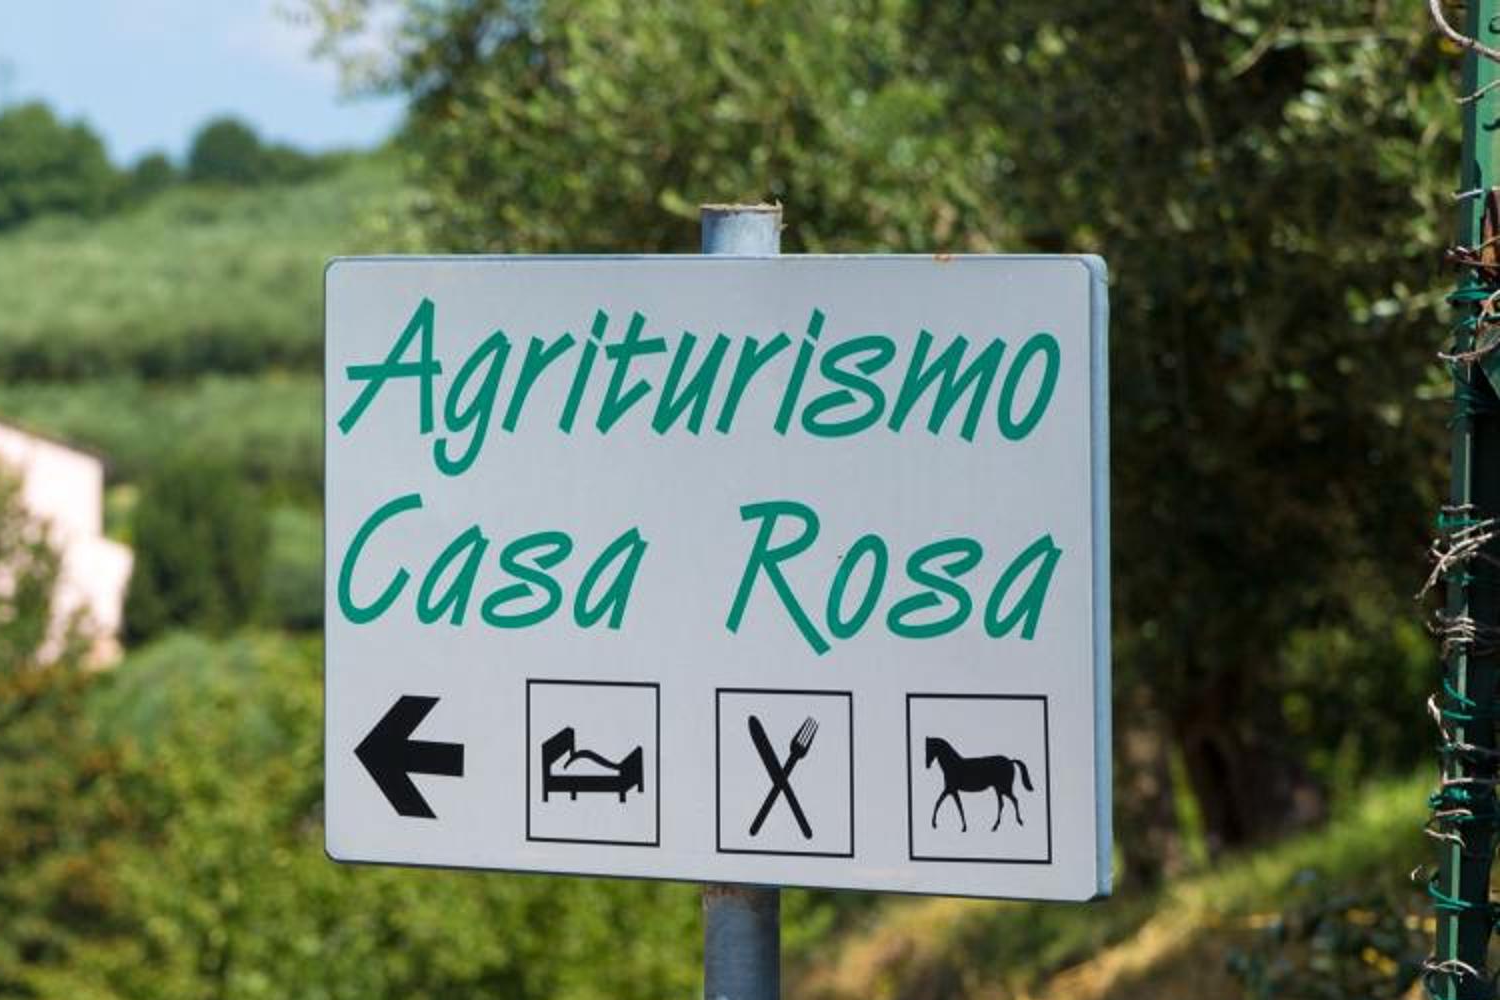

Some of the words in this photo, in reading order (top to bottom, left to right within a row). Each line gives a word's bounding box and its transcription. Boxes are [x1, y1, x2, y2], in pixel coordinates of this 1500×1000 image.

[337, 297, 1062, 478] Agriturismo
[335, 492, 647, 632] Casa
[724, 499, 1062, 657] Rosa
